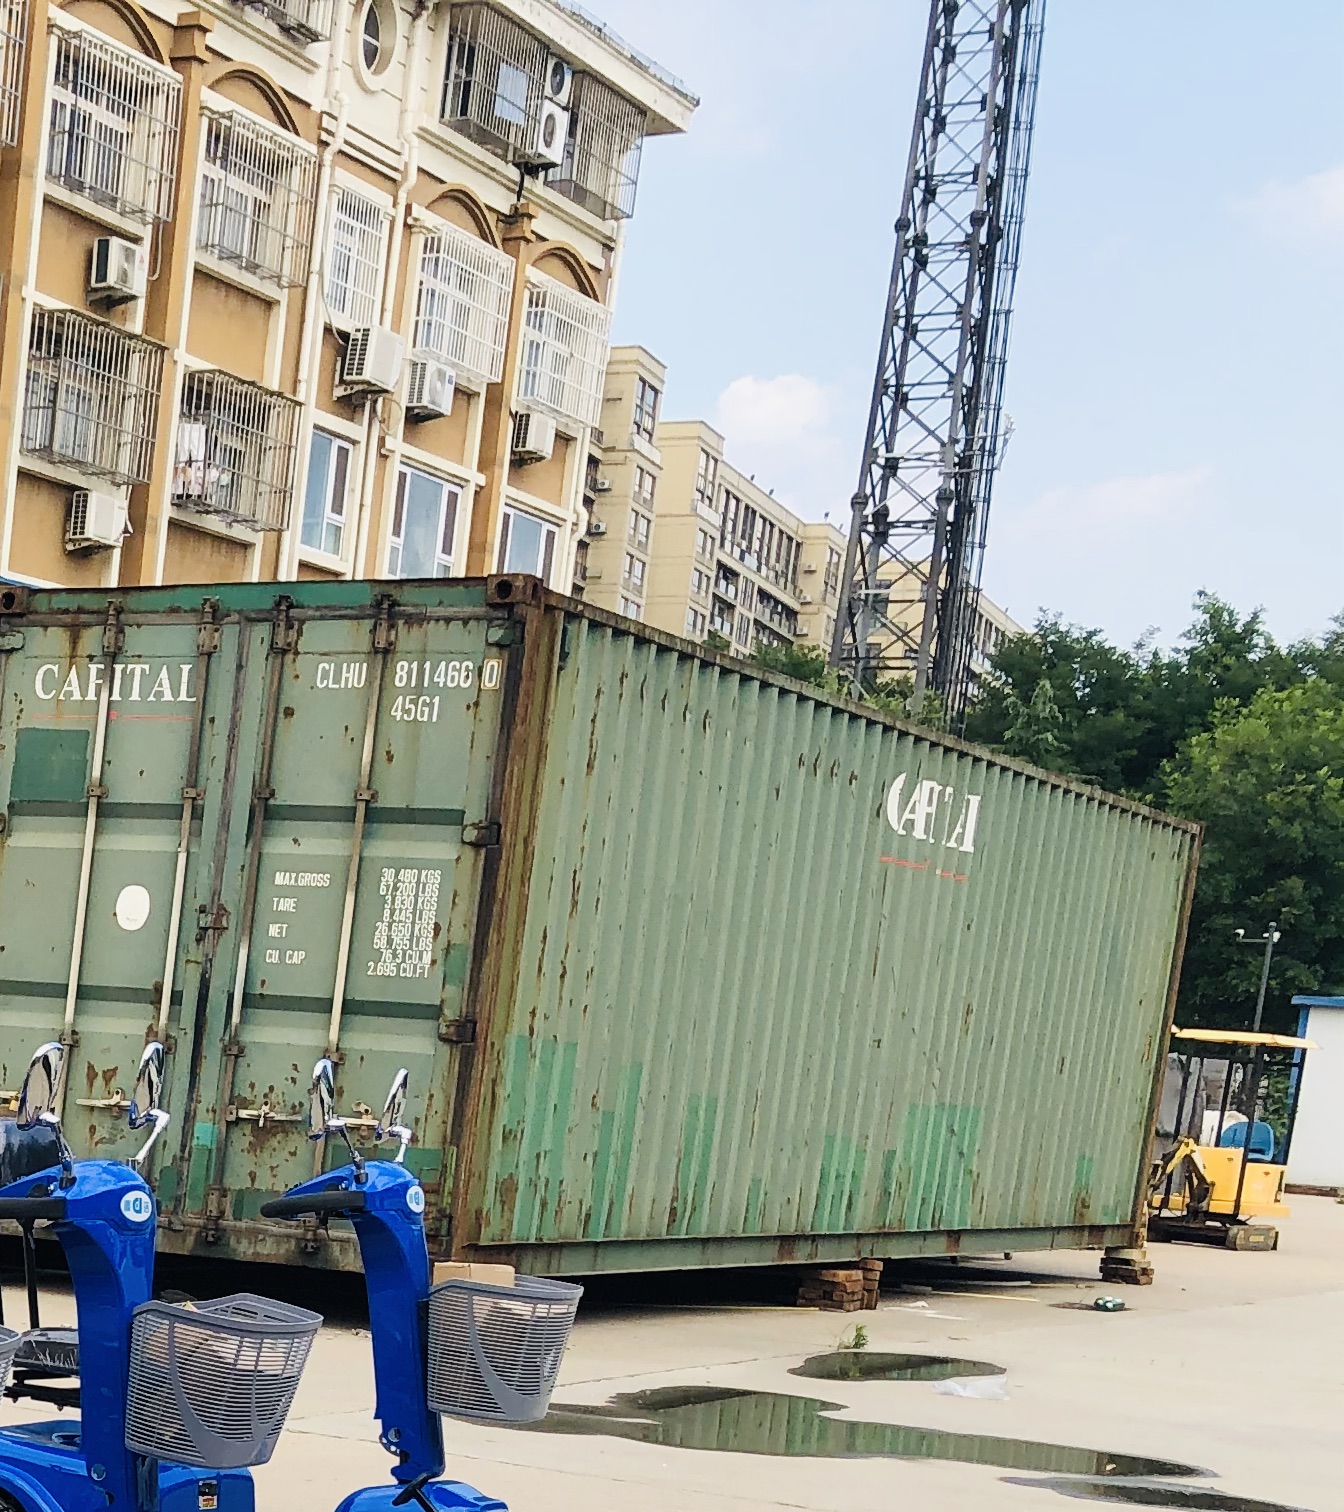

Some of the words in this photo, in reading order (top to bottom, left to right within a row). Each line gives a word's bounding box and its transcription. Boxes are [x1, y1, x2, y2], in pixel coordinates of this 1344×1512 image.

[316, 662, 367, 689] CLHU
[395, 661, 473, 688] 811466
[483, 660, 499, 688] 0
[390, 695, 440, 723] 45G1
[381, 868, 418, 883] 30.480
[421, 869, 441, 883] KGS
[379, 882, 416, 895] 67.200
[419, 883, 439, 897] LBS
[272, 897, 298, 912] TARE
[384, 895, 414, 909] 3.830
[417, 896, 437, 910] KGS
[383, 909, 412, 922] 8.445
[415, 910, 436, 923] LBS
[268, 924, 288, 938] NET
[375, 922, 411, 936] 26.650
[414, 923, 434, 937] KGS
[412, 937, 432, 950] LBS
[285, 950, 306, 964] CAP
[380, 949, 402, 963] 76.3
[367, 961, 397, 976] 2.695
